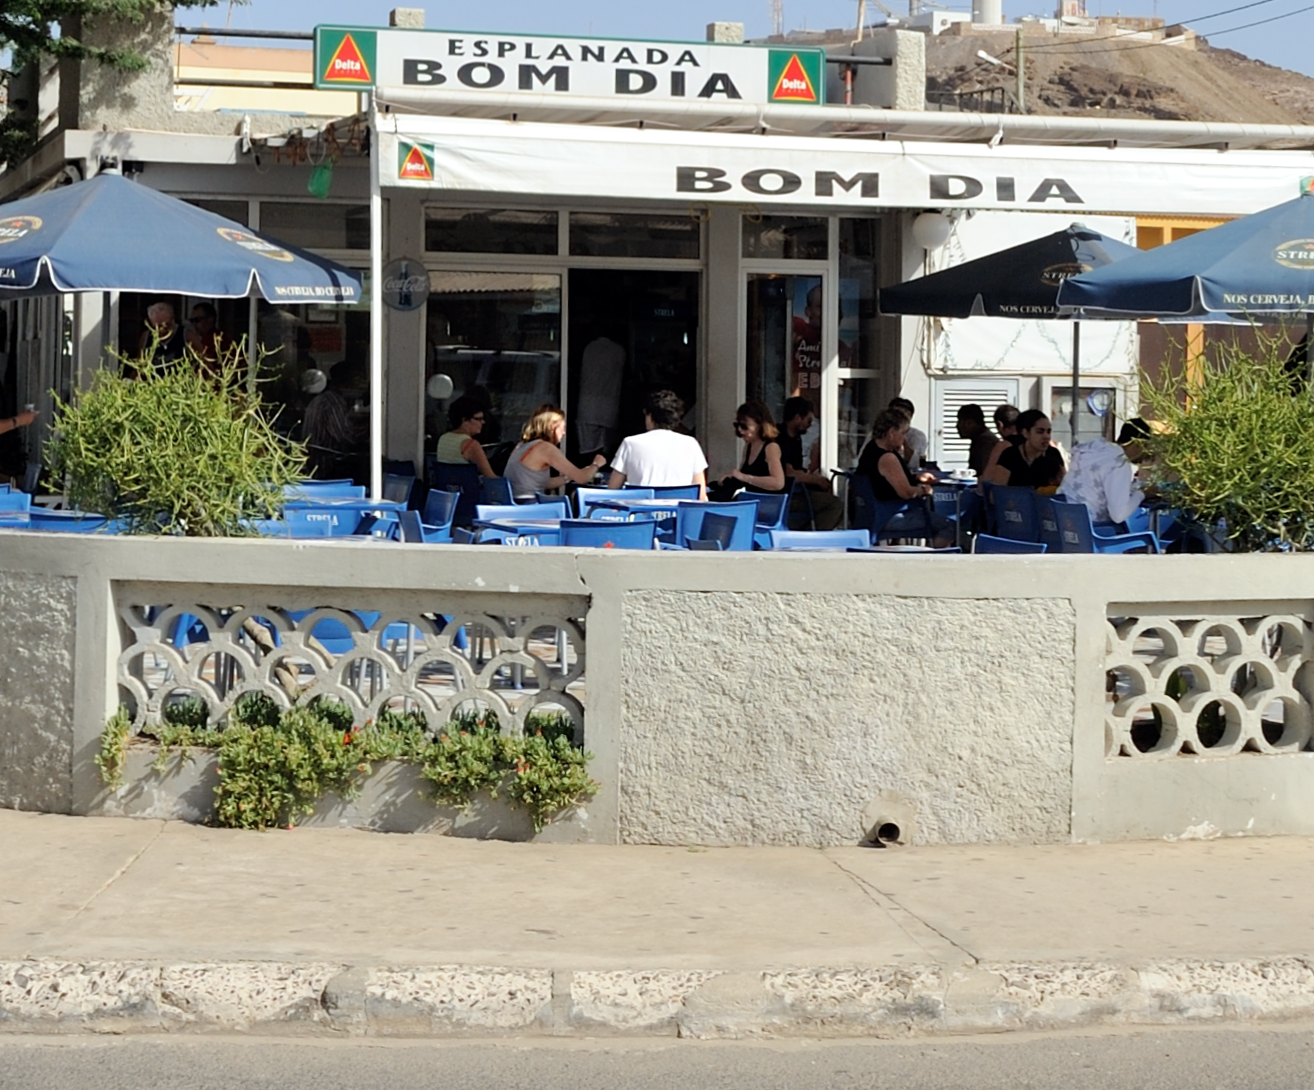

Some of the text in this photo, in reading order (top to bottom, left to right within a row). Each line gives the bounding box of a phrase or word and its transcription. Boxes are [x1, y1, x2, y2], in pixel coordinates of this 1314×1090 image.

[448, 39, 701, 67] ESPLANADA
[334, 59, 361, 70] Delta
[403, 58, 743, 100] BOM DIA
[782, 78, 807, 90] Delta
[676, 166, 1084, 204] BOM DIA
[1222, 293, 1247, 304] NOS
[1249, 294, 1306, 306] CERVEJA,
[999, 304, 1055, 314] NOS CERVEJ
[934, 492, 958, 502] STRELA
